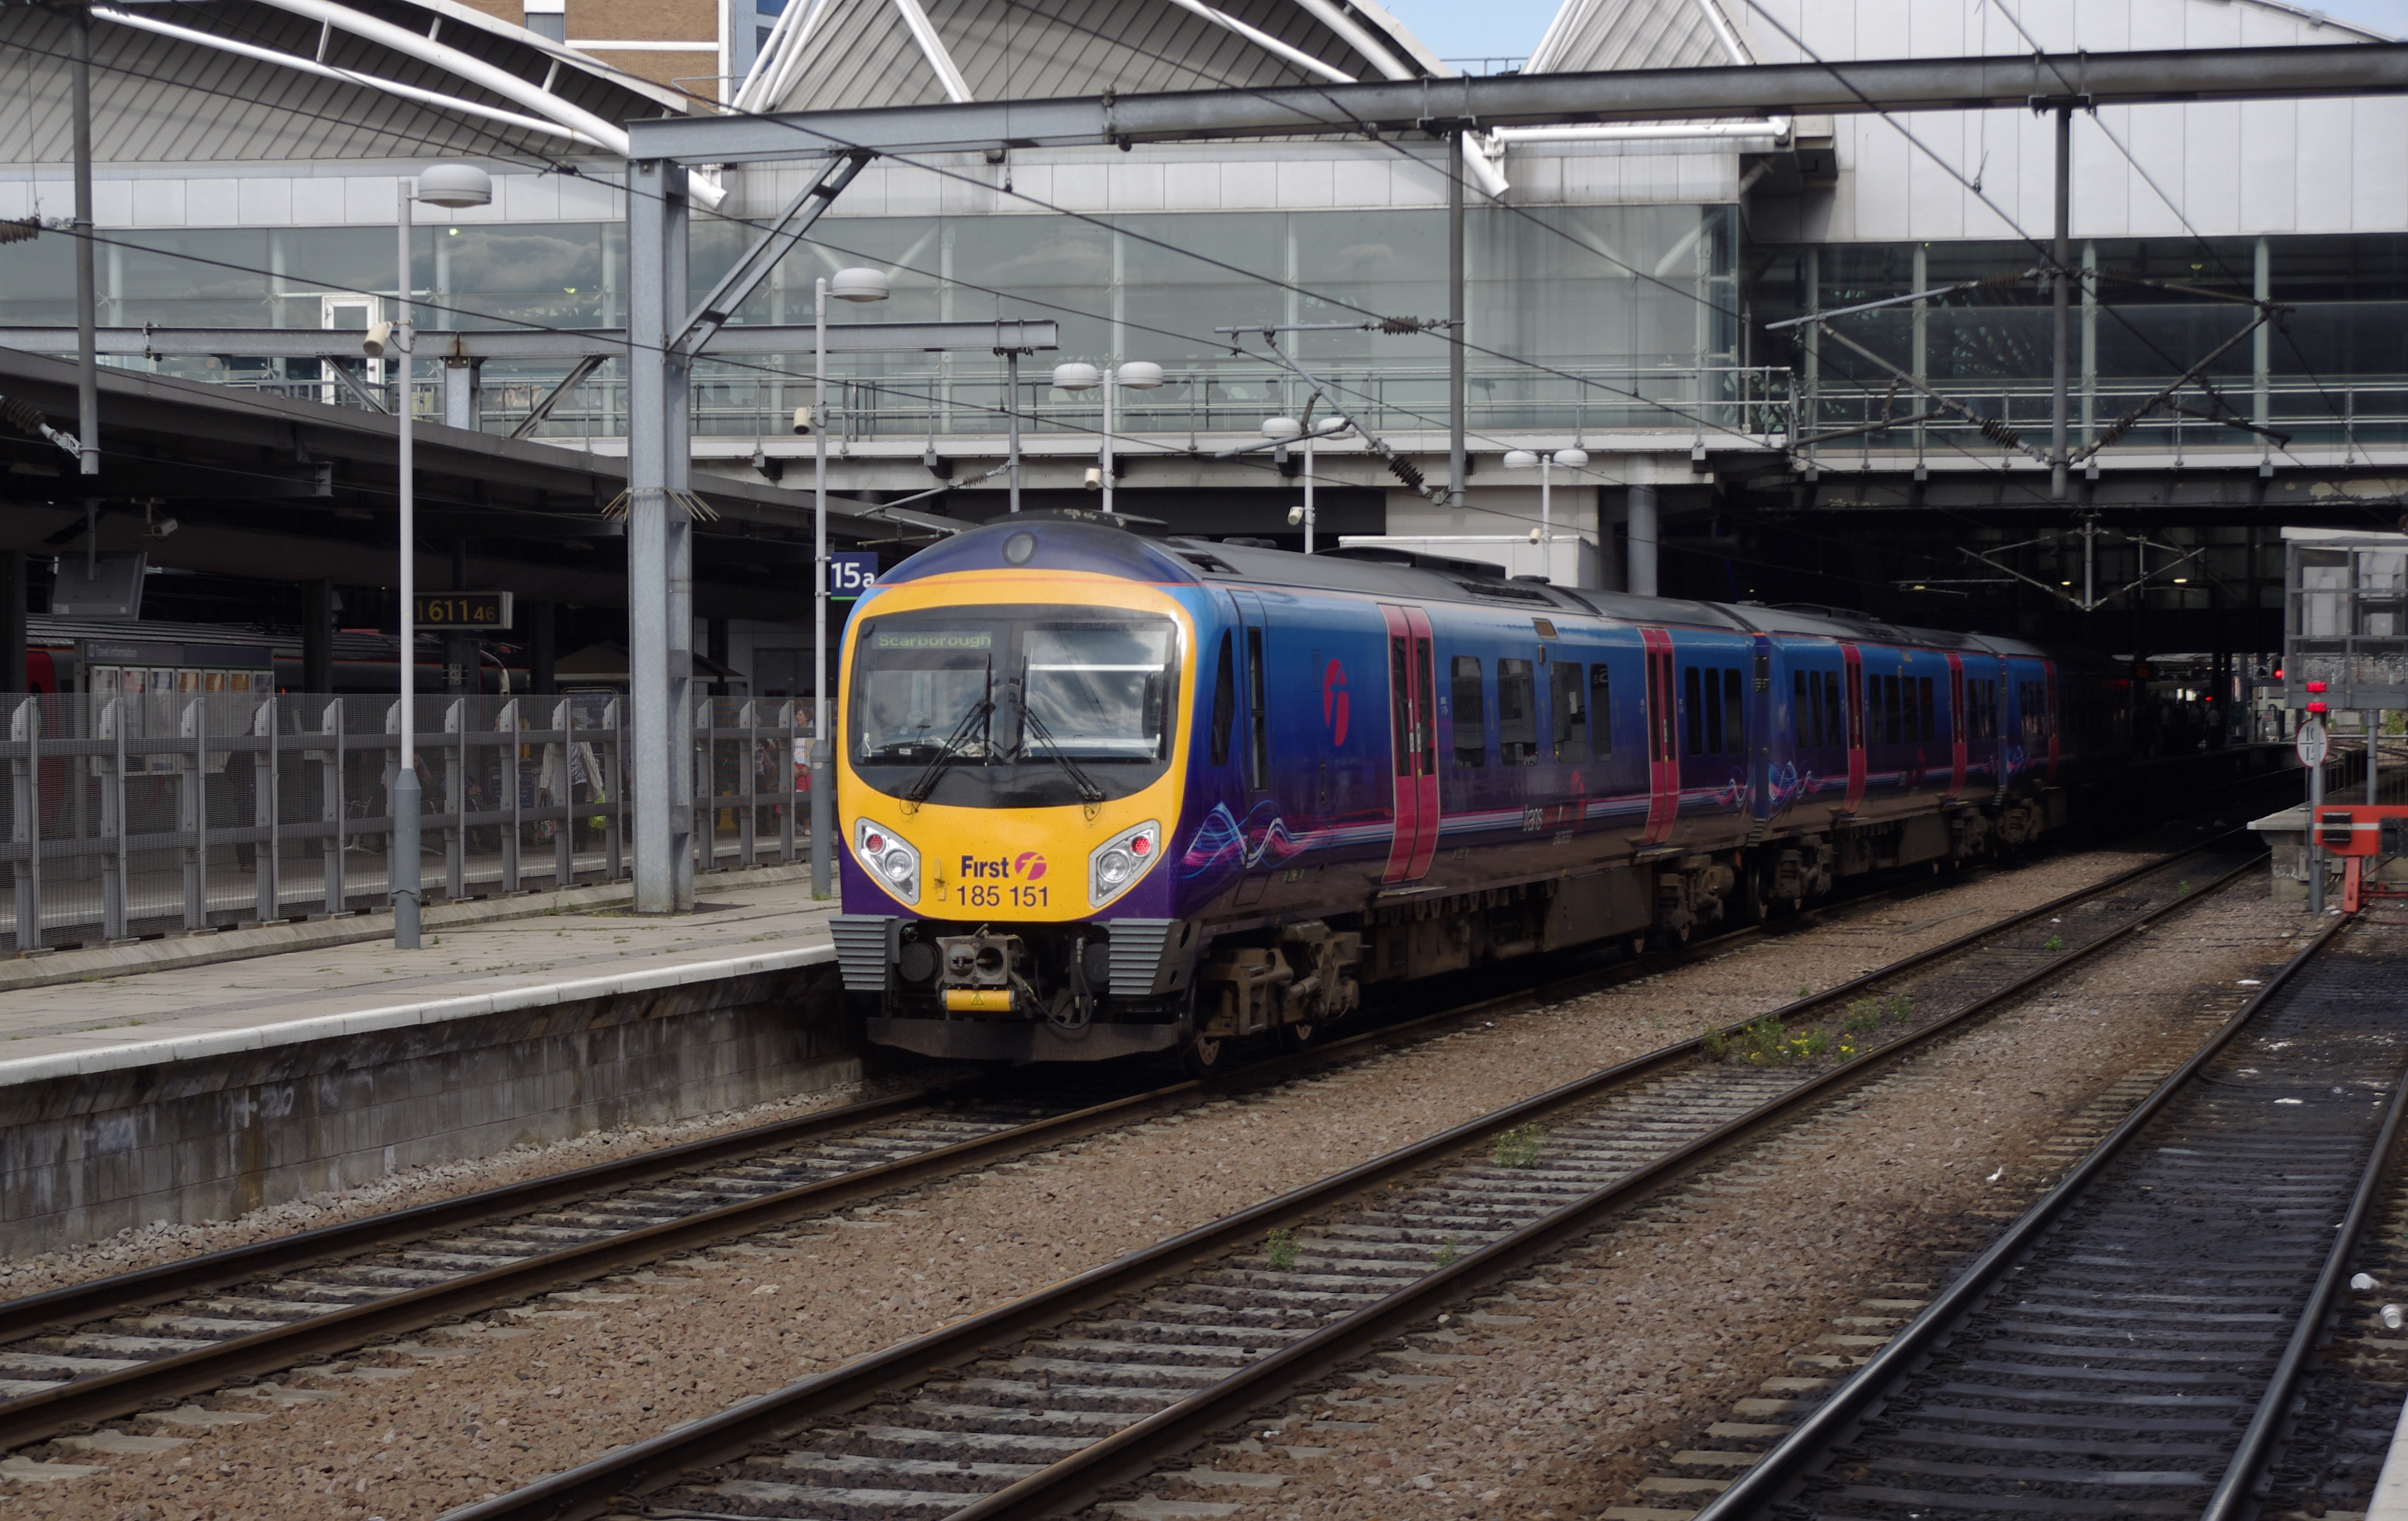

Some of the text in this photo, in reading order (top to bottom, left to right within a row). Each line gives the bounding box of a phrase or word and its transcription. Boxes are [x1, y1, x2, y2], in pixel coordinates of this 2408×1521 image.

[831, 562, 875, 588] 15a
[95, 644, 137, 657] Travel information
[878, 634, 992, 648] Scarborough
[961, 855, 1009, 878] First
[957, 885, 1048, 907] 185 151
